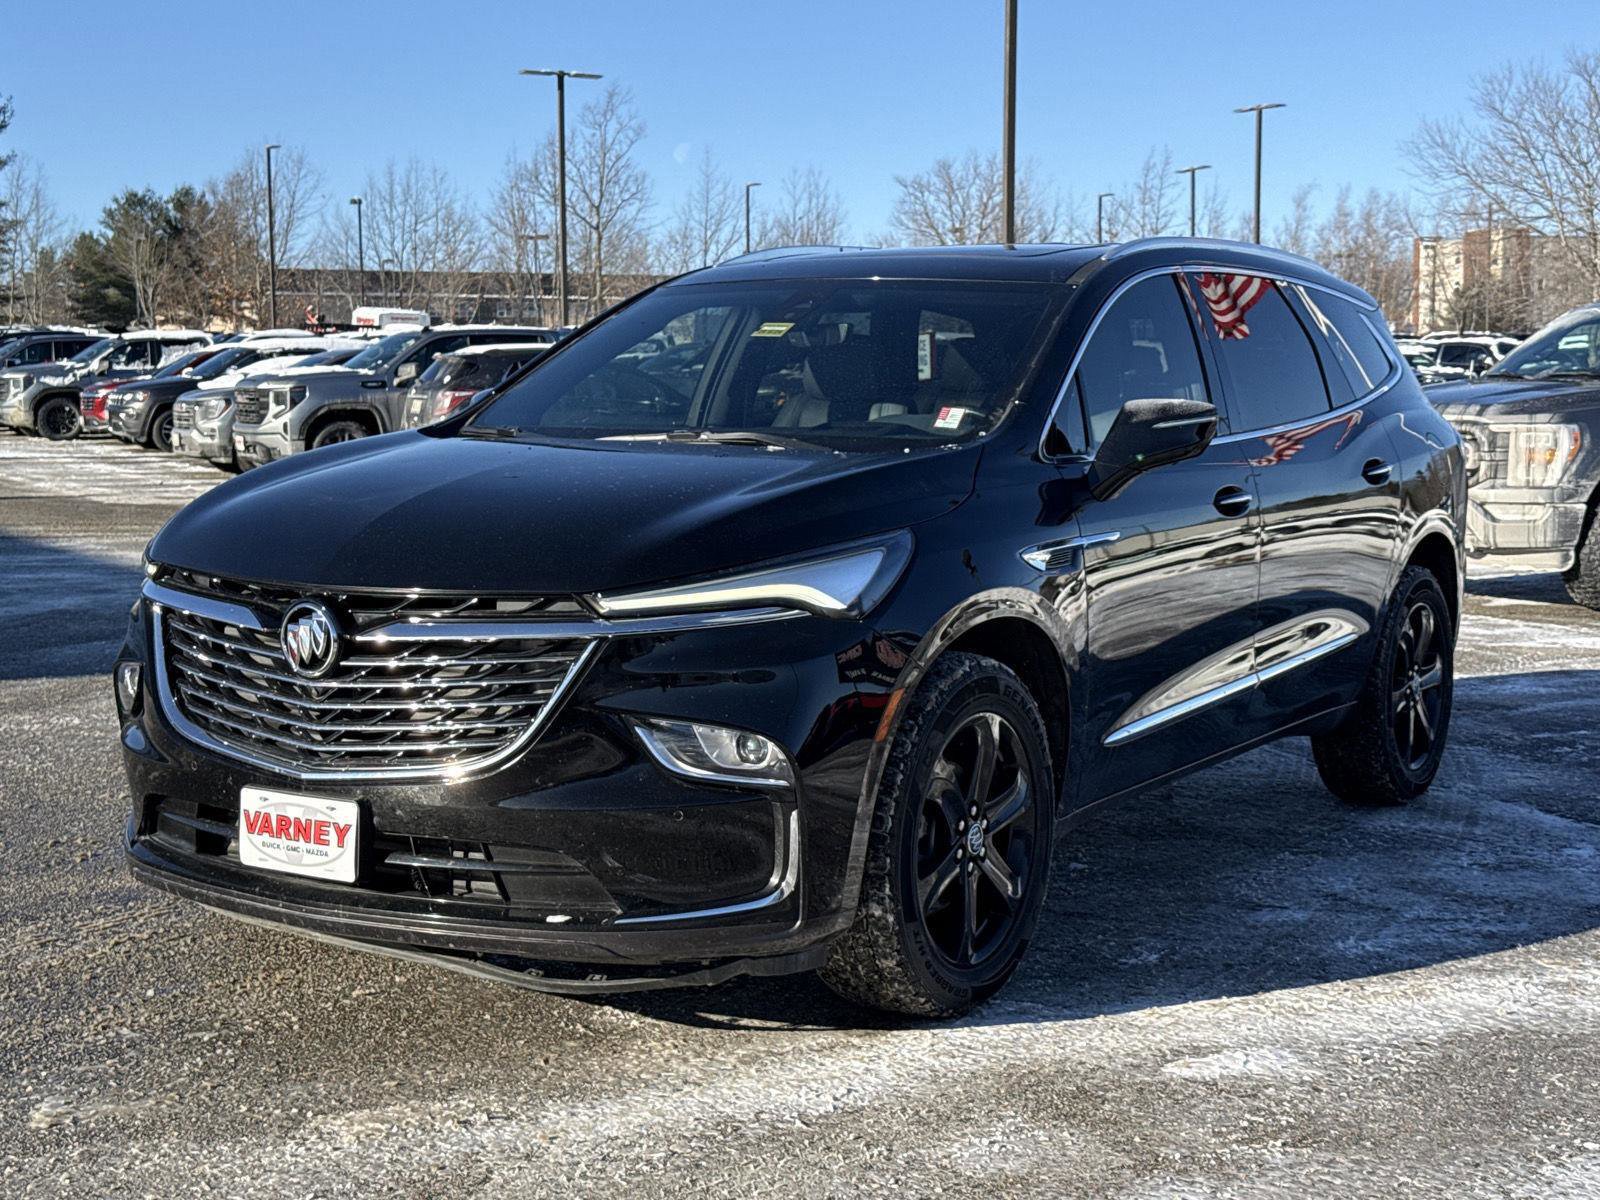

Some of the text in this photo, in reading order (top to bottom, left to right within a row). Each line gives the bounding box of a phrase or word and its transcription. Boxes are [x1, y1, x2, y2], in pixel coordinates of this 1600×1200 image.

[243, 809, 352, 848] VARNEY
[261, 841, 281, 850] BUICK
[305, 848, 328, 857] MAZDA
